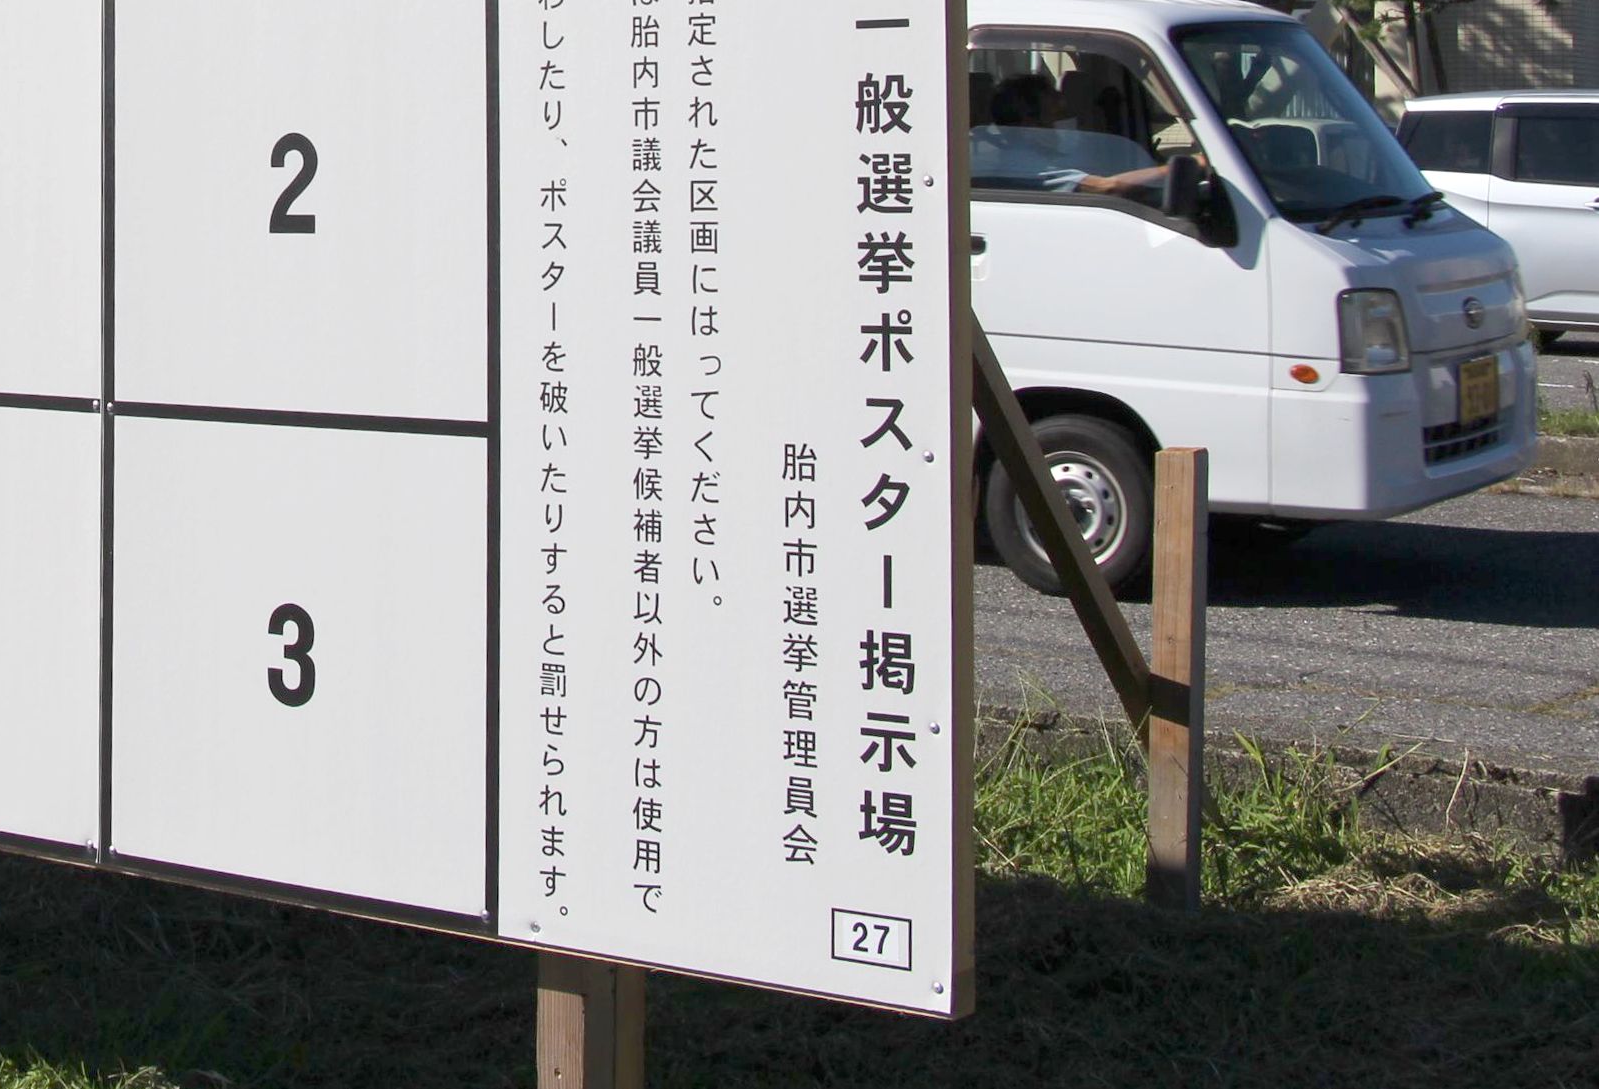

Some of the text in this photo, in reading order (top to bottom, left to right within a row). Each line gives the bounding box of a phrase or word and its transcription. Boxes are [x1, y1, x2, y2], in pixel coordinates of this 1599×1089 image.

[268, 132, 319, 234] 2
[267, 602, 316, 708] 3
[781, 442, 819, 866] 胎内市選挙管理員会
[851, 920, 892, 956] 27
